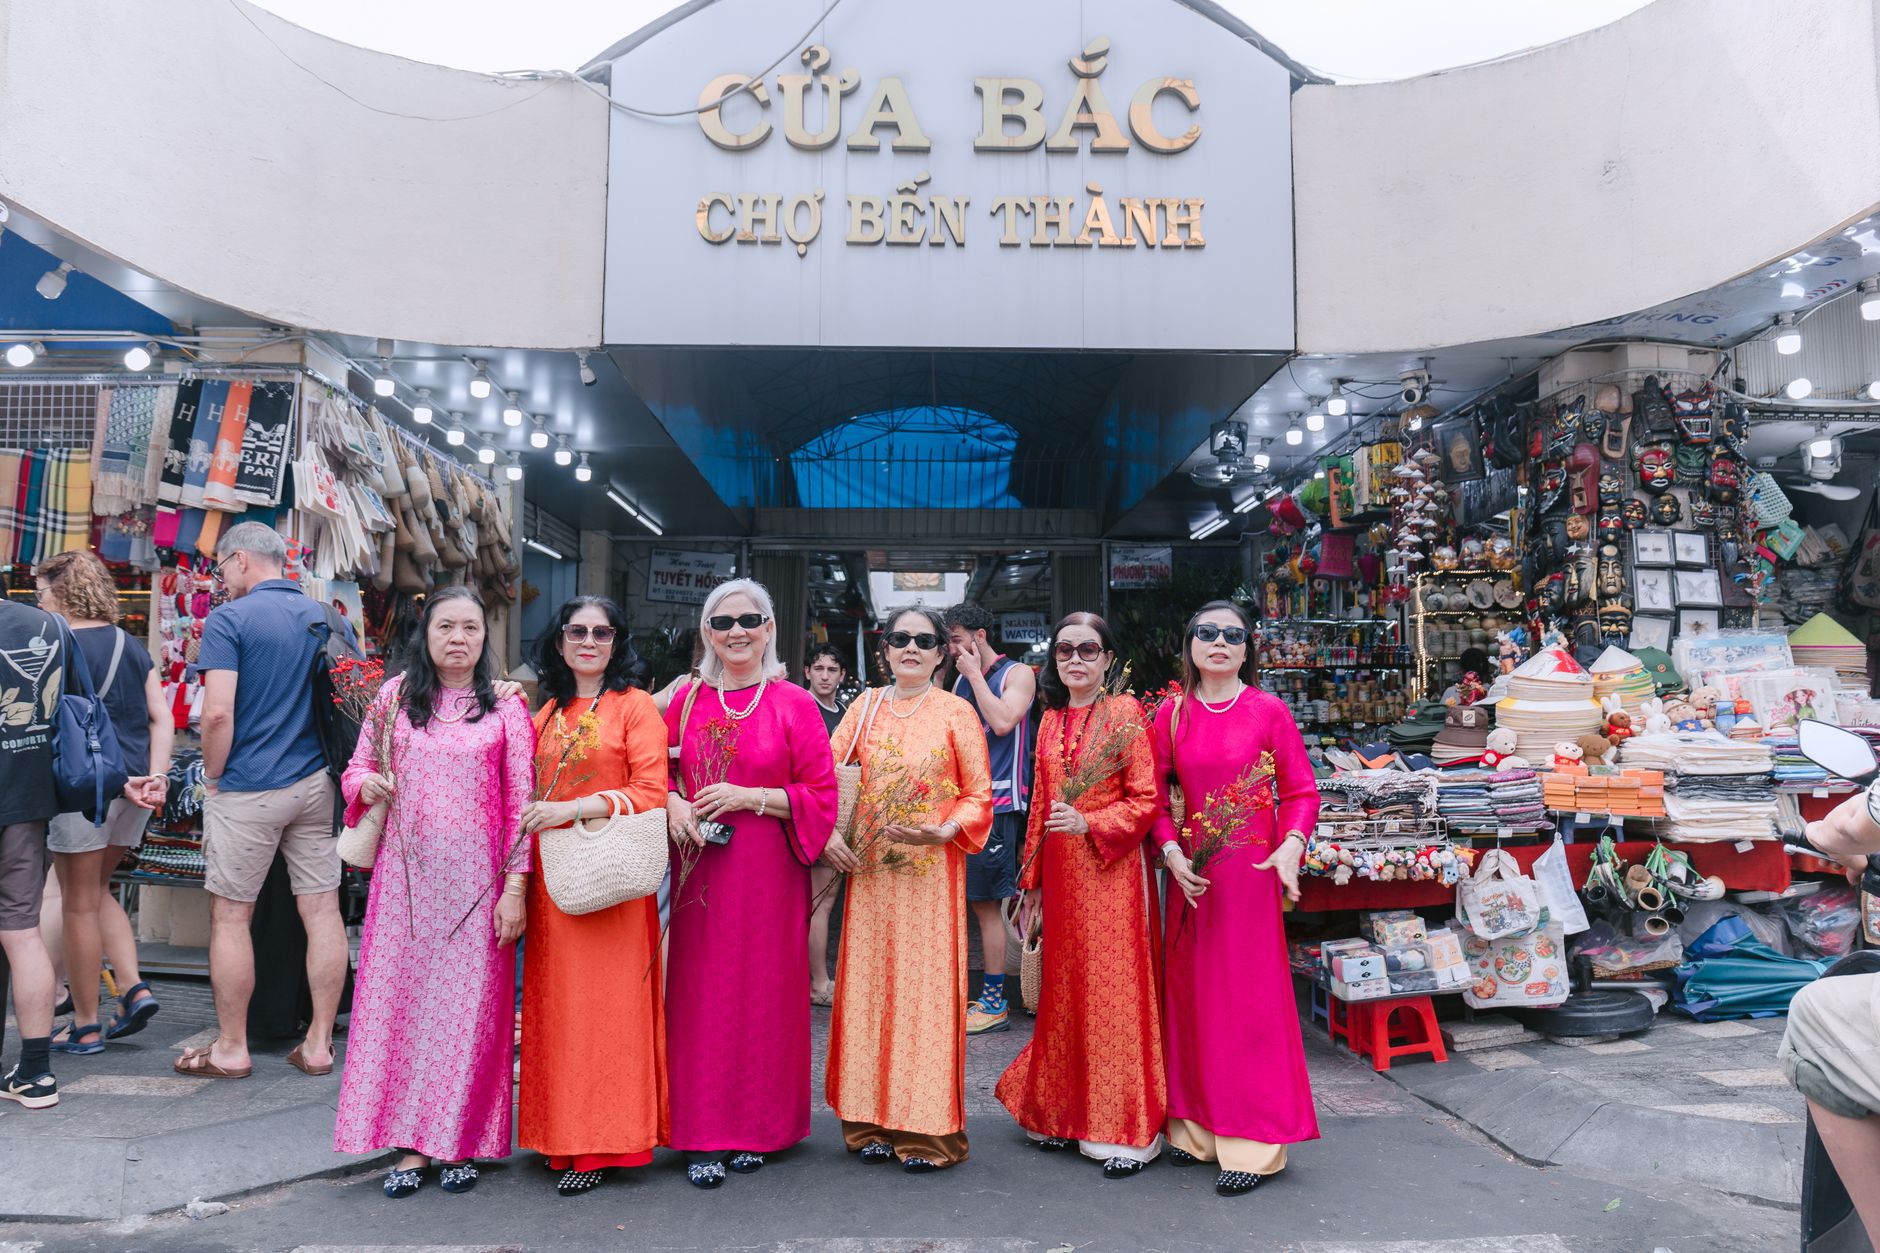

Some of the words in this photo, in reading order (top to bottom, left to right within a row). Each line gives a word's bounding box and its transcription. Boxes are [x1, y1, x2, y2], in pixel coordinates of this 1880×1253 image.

[698, 44, 932, 152] CỬA
[973, 37, 1203, 154] BẮC
[696, 189, 826, 258] CHỢ
[845, 171, 970, 247] BẾN
[990, 182, 1207, 248] THÀNH
[177, 402, 196, 422] H
[654, 568, 693, 588] TUYẾT
[1005, 629, 1043, 640] WATCH
